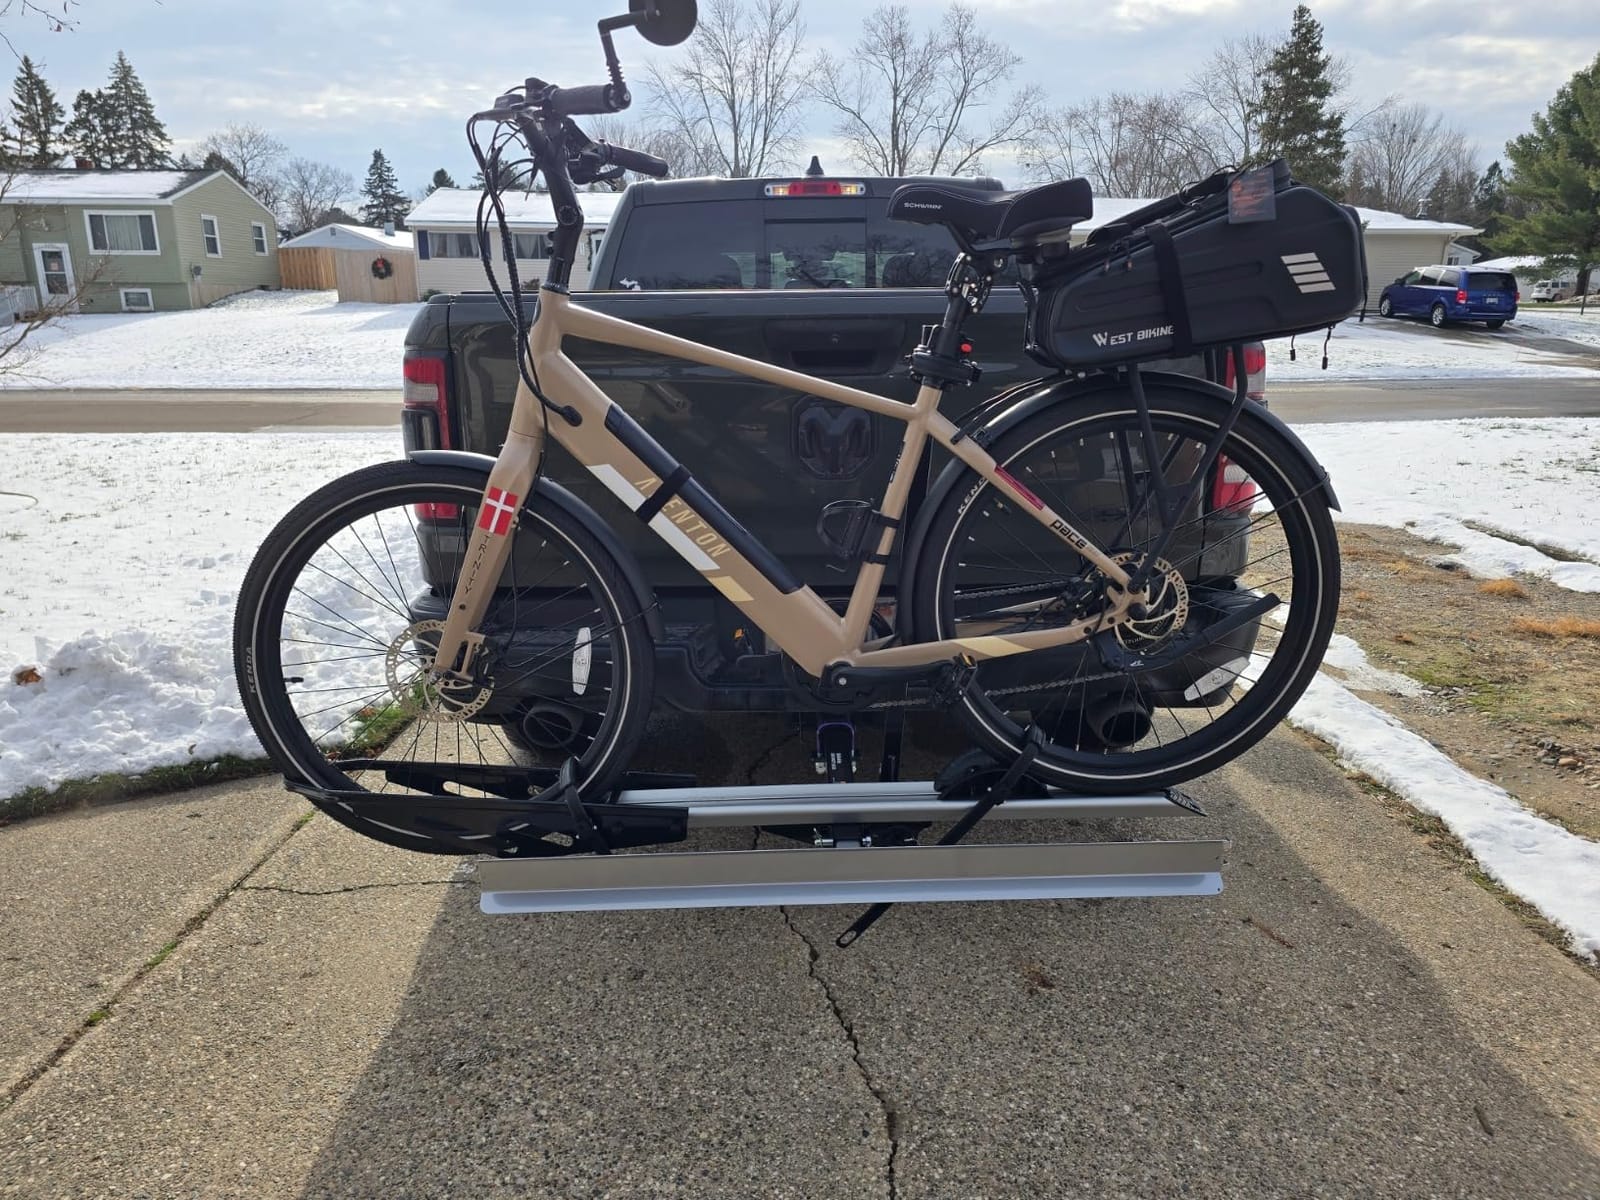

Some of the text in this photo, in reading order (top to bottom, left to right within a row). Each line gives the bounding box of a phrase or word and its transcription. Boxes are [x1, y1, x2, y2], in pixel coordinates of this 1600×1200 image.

[1092, 331, 1134, 347] WEST
[957, 476, 988, 515] KEND
[634, 477, 731, 557] AENTON
[1050, 519, 1088, 549] pace
[465, 534, 490, 594] TRINITY
[246, 647, 256, 693] KENDA
